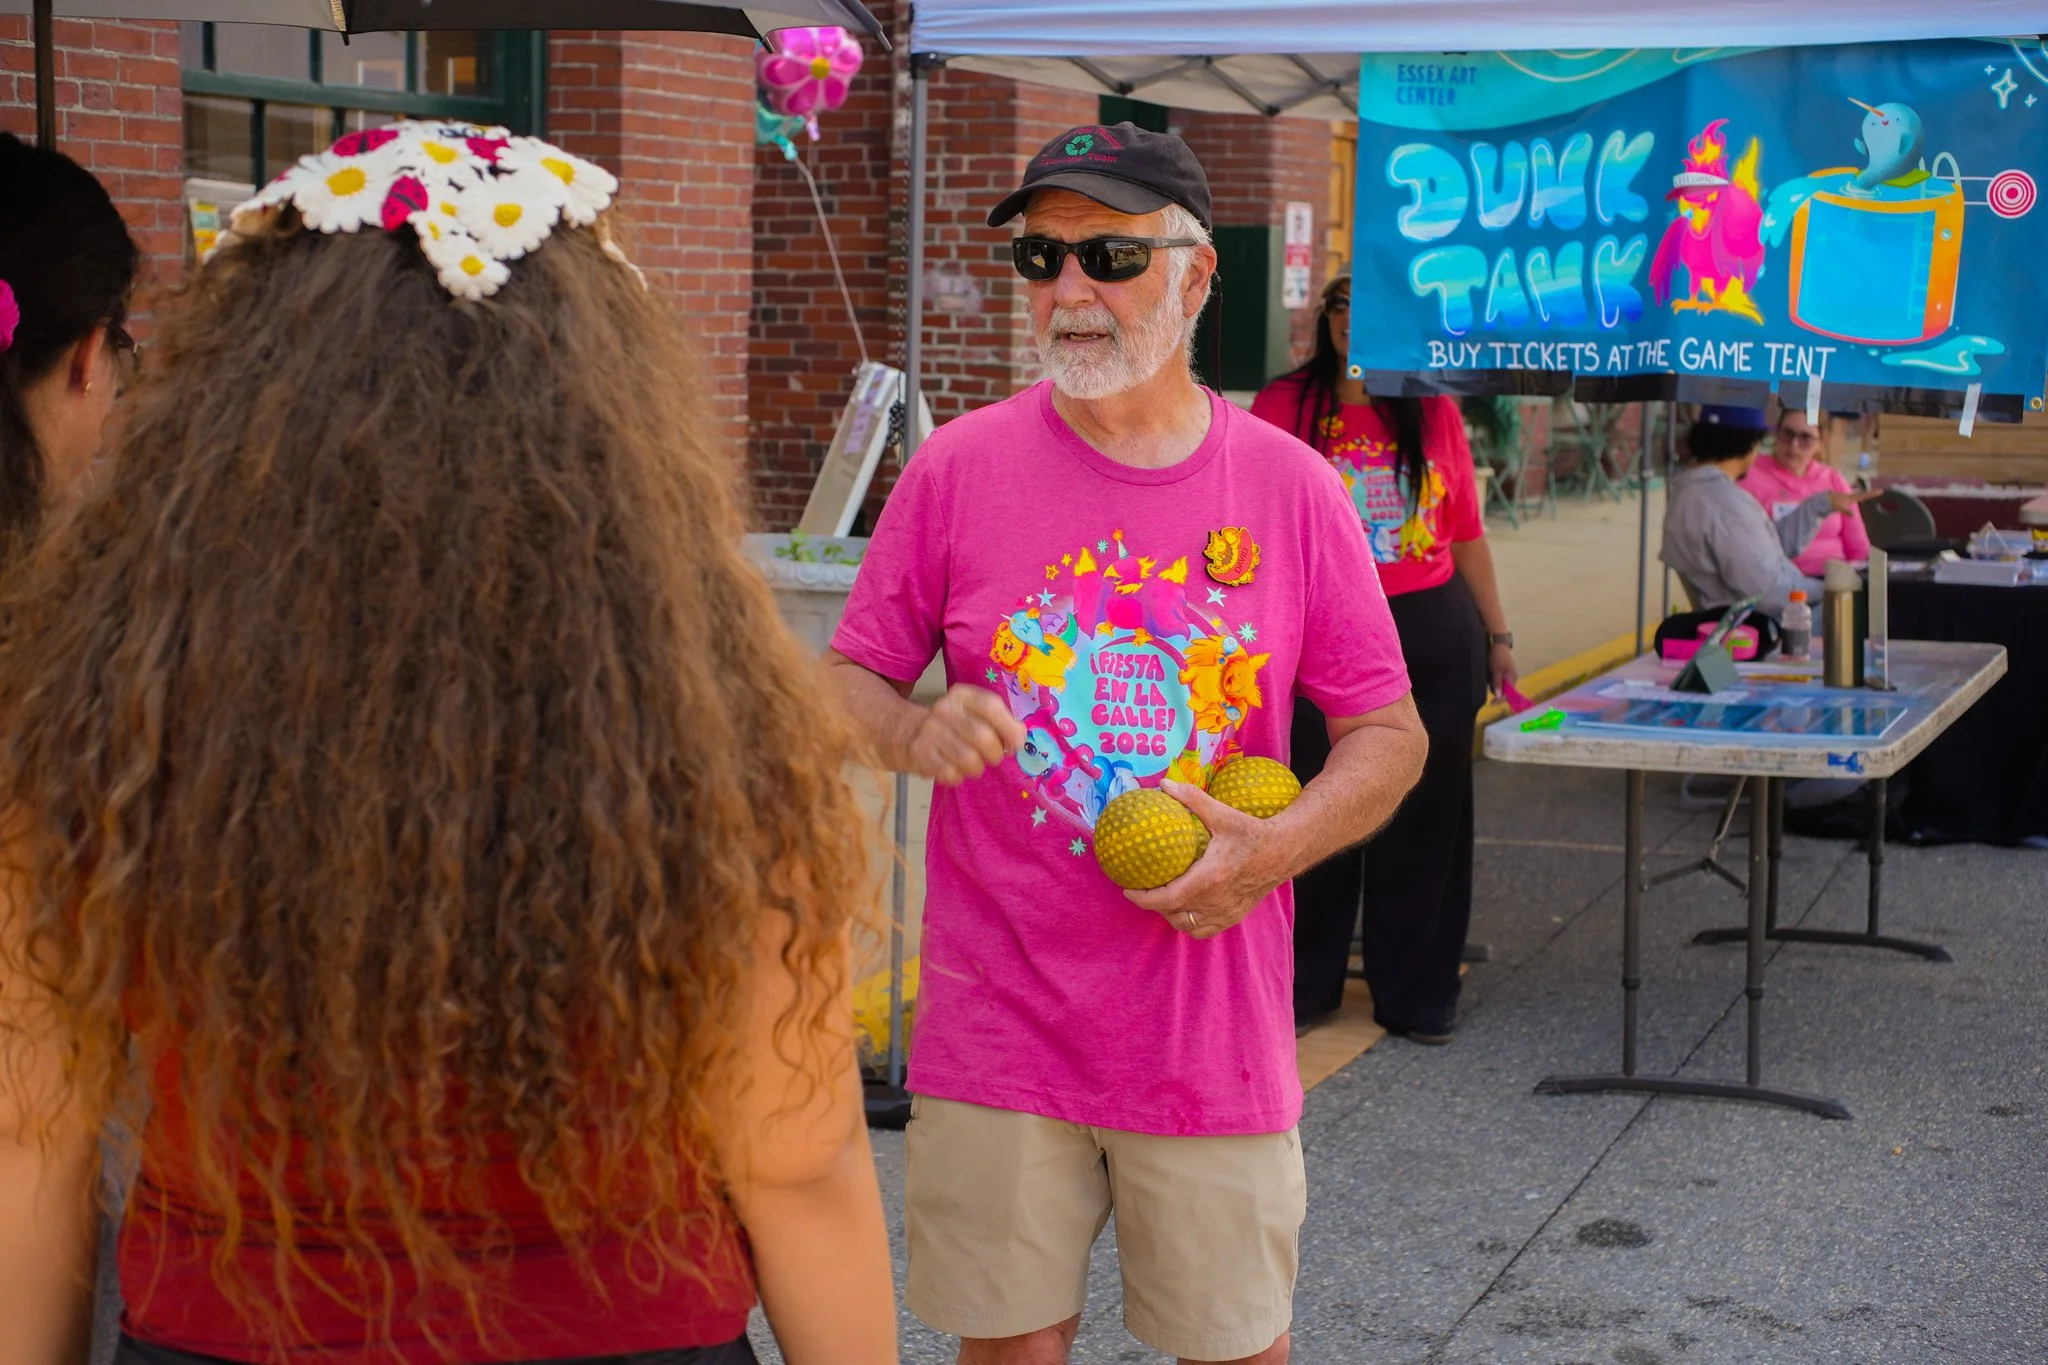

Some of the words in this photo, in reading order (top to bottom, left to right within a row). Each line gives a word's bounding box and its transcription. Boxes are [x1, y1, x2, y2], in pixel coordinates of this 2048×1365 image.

[1397, 64, 1445, 84] ESSEX
[1449, 65, 1477, 86] ART
[1396, 86, 1456, 106] CENTER
[1385, 129, 1655, 243] DUNK
[1407, 233, 1648, 336] TANK
[1427, 340, 1482, 369] BUY
[1488, 342, 1601, 372] TICKETS
[1607, 344, 1634, 372] AT
[1637, 338, 1672, 368] THE
[1679, 336, 1754, 373] GAME
[1763, 341, 1837, 380] TENT
[1234, 547, 1249, 574] DAVID
[1094, 677, 1129, 704] EN
[1133, 682, 1168, 707] LA
[1090, 703, 1176, 732] CALLE!
[1098, 731, 1168, 757] 2026
